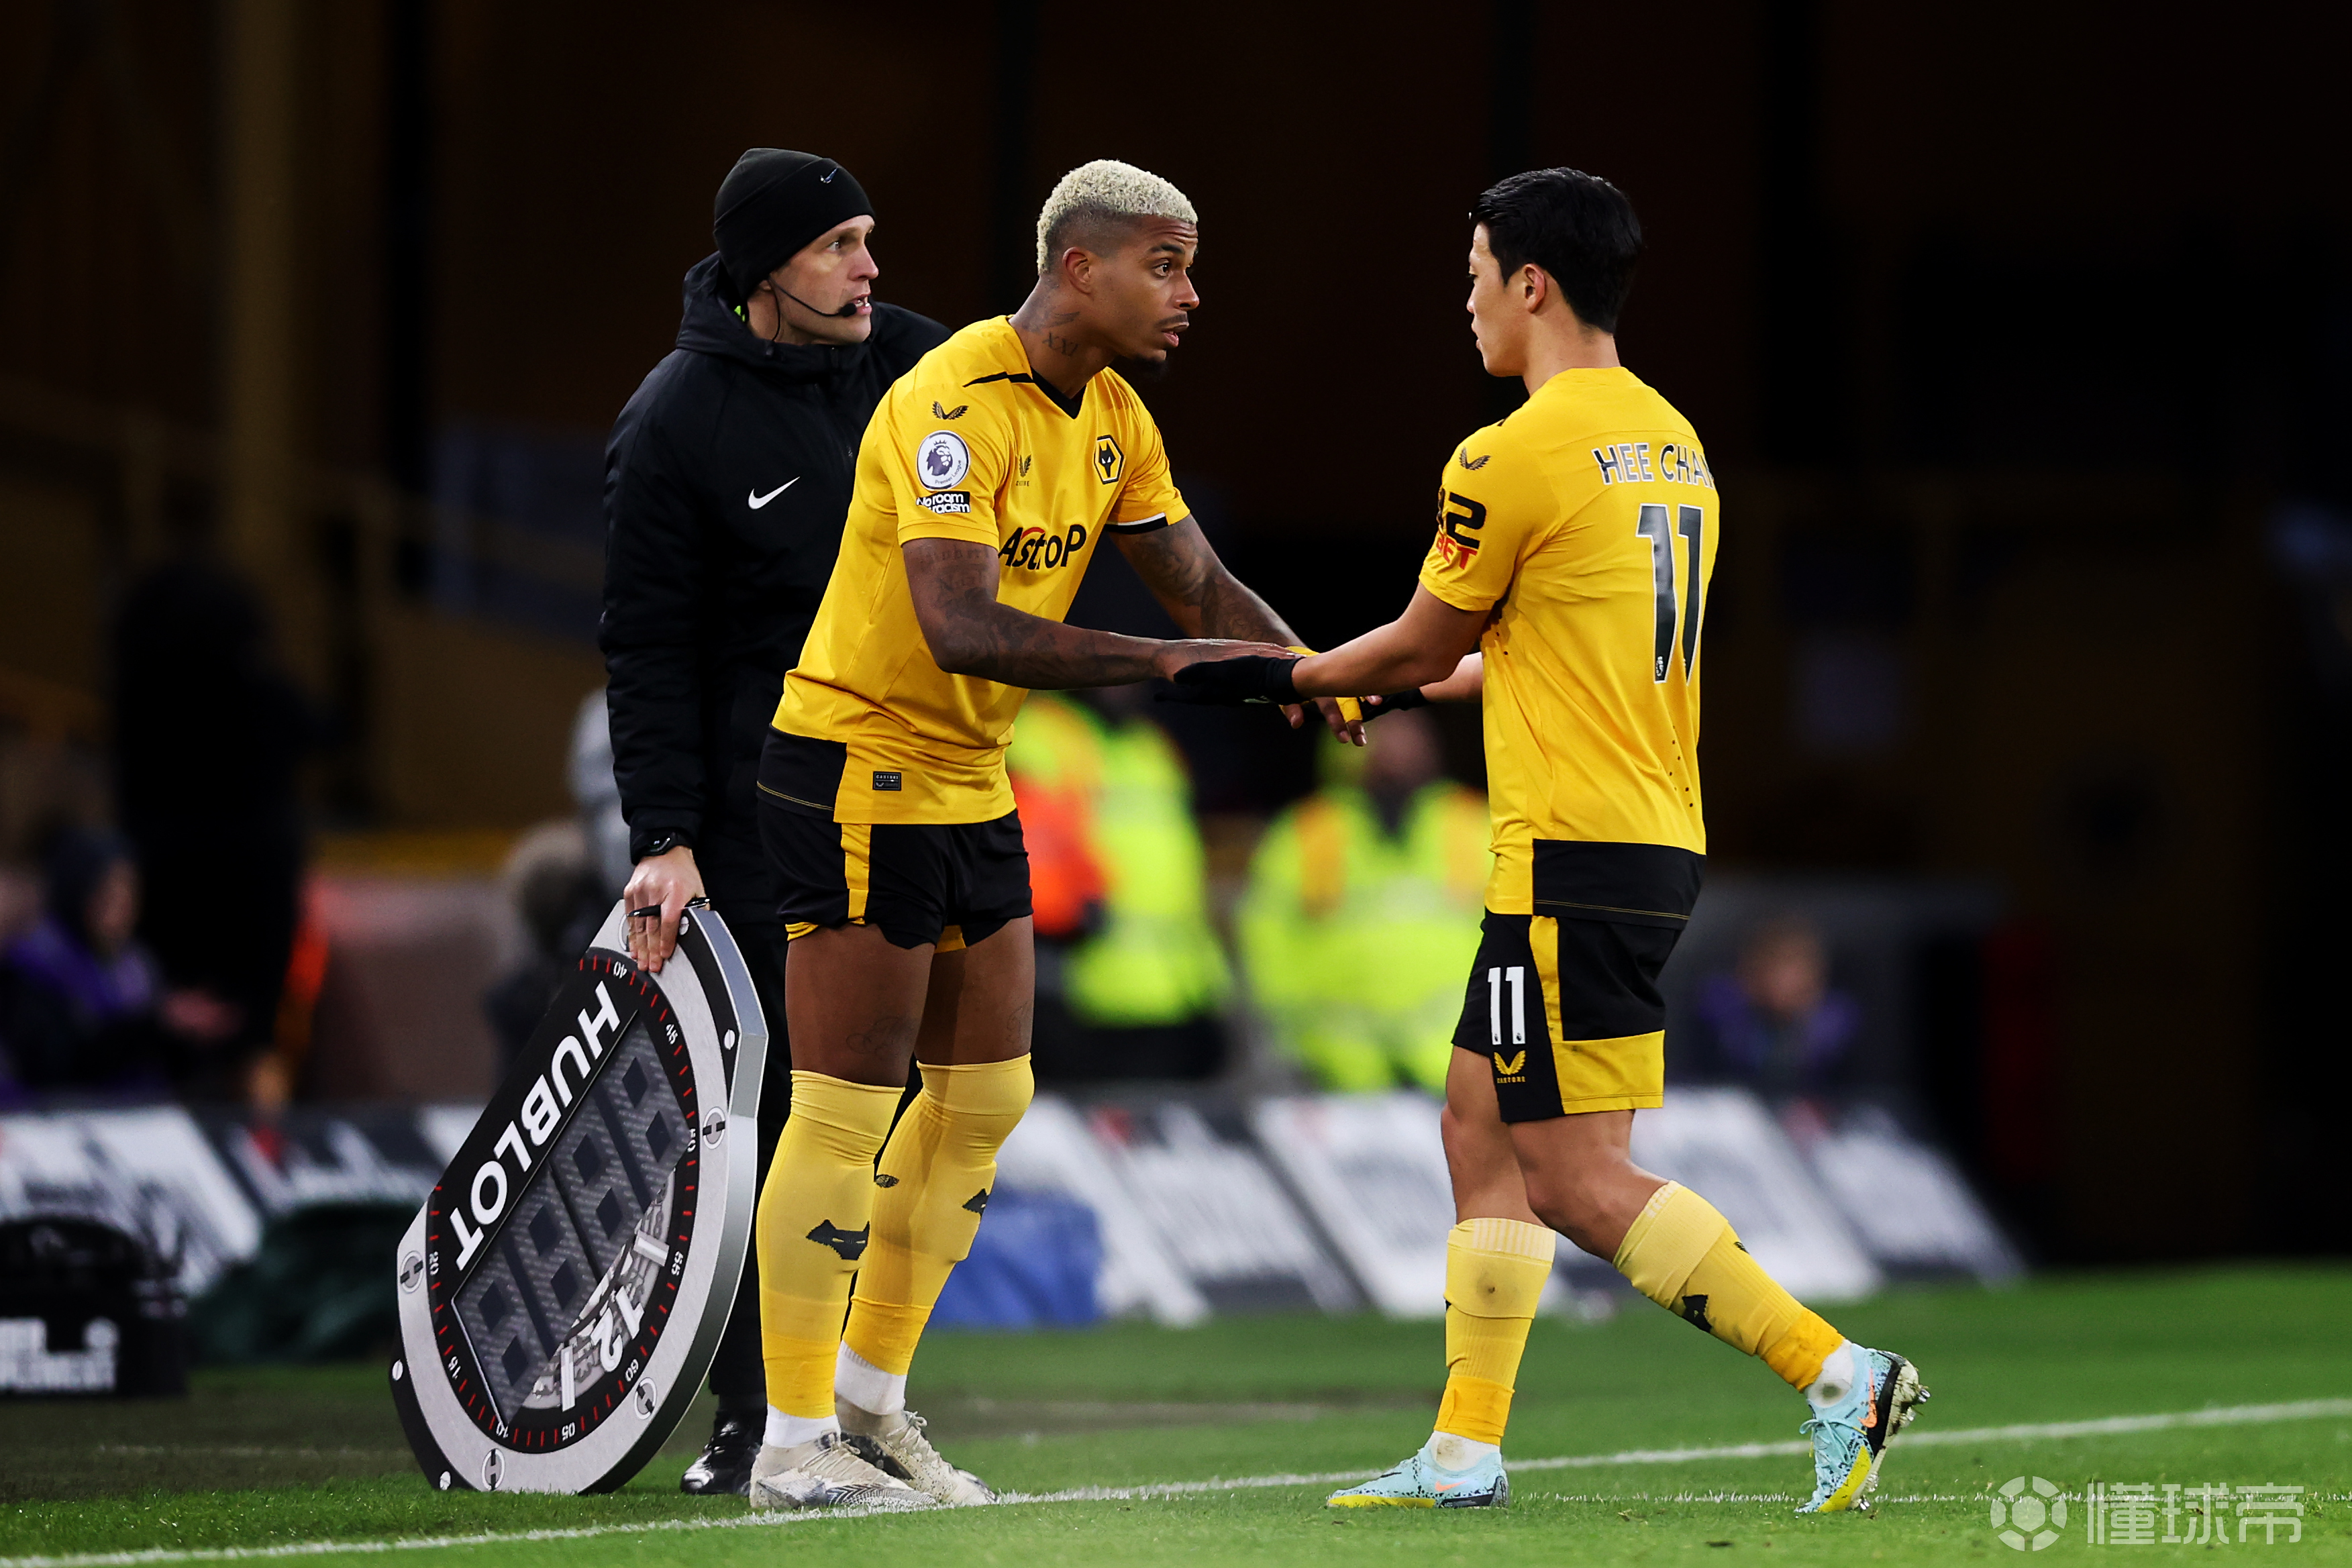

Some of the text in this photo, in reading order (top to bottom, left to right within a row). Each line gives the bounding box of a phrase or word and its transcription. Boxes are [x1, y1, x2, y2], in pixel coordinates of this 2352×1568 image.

[1591, 442, 1655, 485] HEE
[916, 493, 964, 507] No room
[932, 503, 970, 514] racism
[998, 524, 1086, 570] AstoP
[1436, 534, 1478, 570] BET
[1635, 503, 1703, 686] 11
[613, 961, 627, 979] 40
[1488, 966, 1525, 1045] 11
[666, 1024, 678, 1045] 45
[450, 980, 621, 1271] HUBLOT
[429, 1251, 439, 1275] 20
[670, 1251, 683, 1276] 55
[591, 1286, 645, 1372] 12
[448, 1355, 461, 1379] 15
[625, 1359, 639, 1381] 60
[562, 1422, 576, 1441] 05
